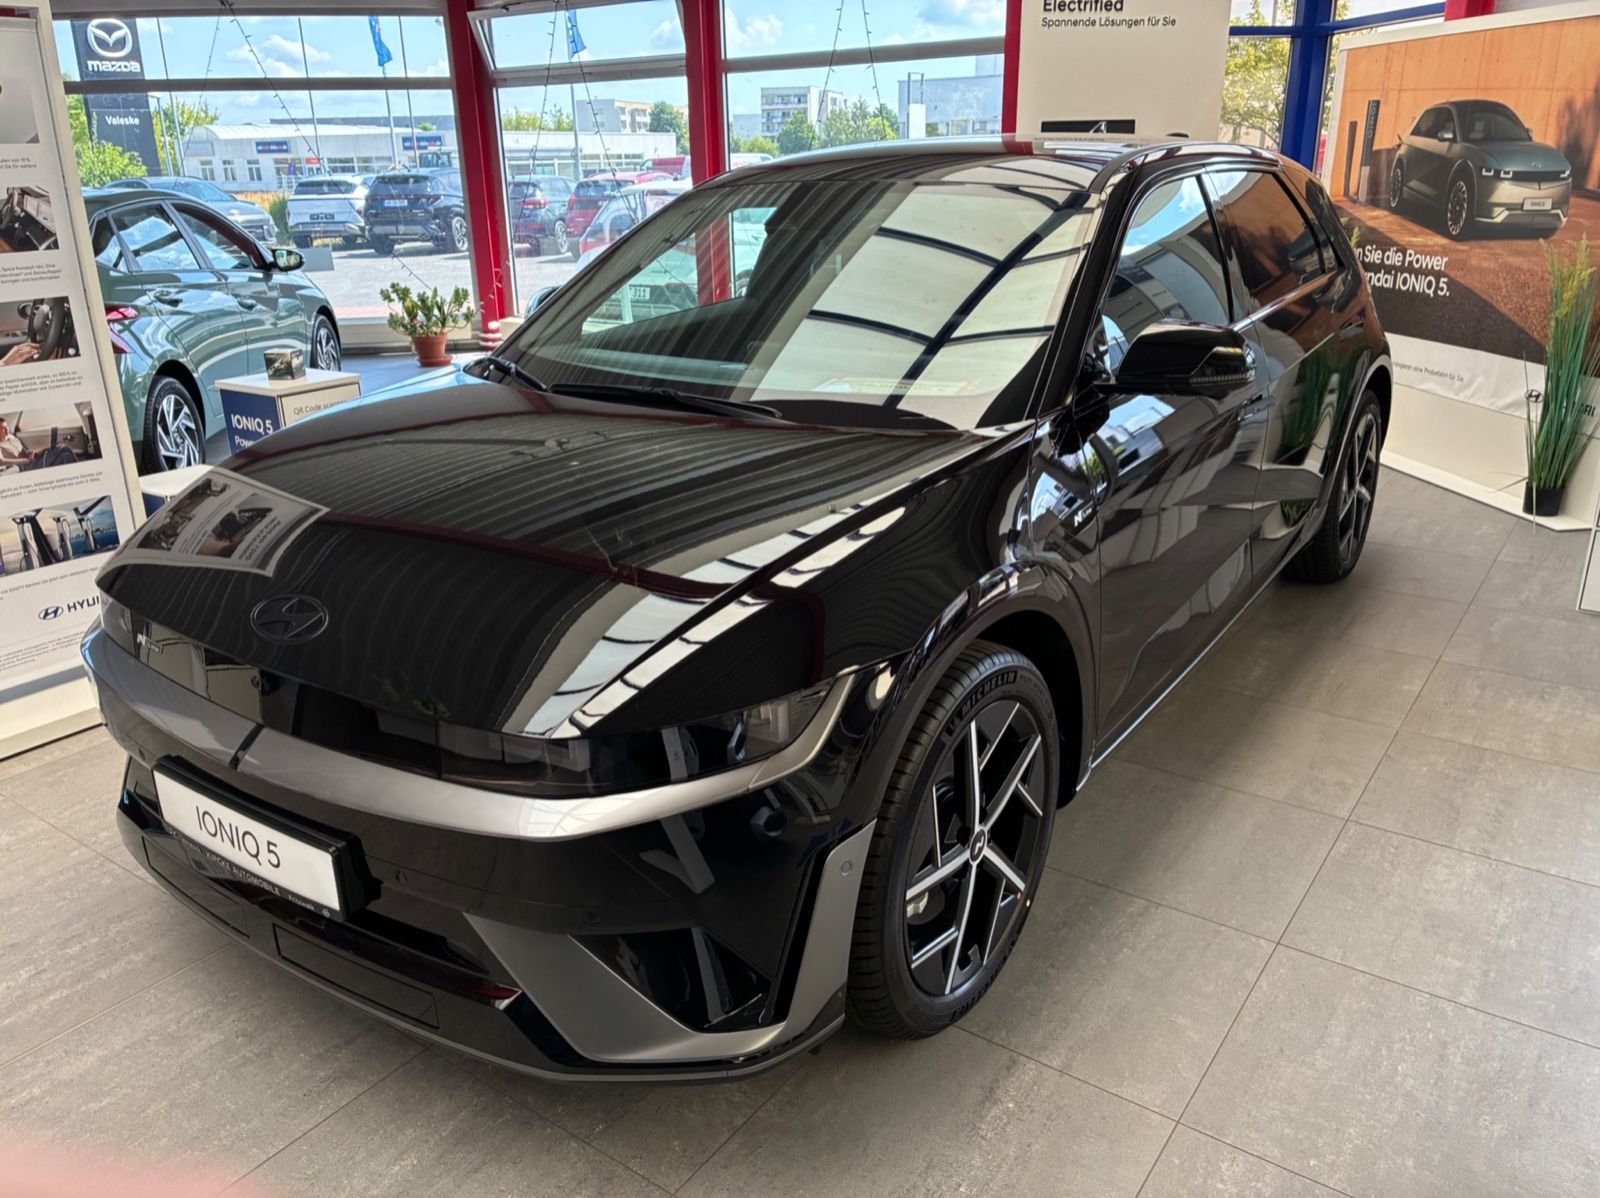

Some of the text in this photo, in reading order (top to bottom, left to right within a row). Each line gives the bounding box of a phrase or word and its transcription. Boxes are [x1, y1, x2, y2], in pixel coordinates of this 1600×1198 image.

[1042, 0, 1124, 12] Electrified
[1041, 16, 1176, 29] Spannende Lösungen für Sie
[86, 60, 141, 73] mazda
[105, 115, 140, 126] Valeske
[1364, 244, 1383, 264] Sie
[1384, 246, 1403, 266] die
[1405, 249, 1449, 272] Power
[1365, 268, 1450, 298] ndai IONIQ 5.
[293, 406, 304, 416] QR
[231, 413, 274, 435] IONIQ 5
[961, 670, 1017, 718] MICHELIN
[196, 805, 281, 869] IONIQ 5
